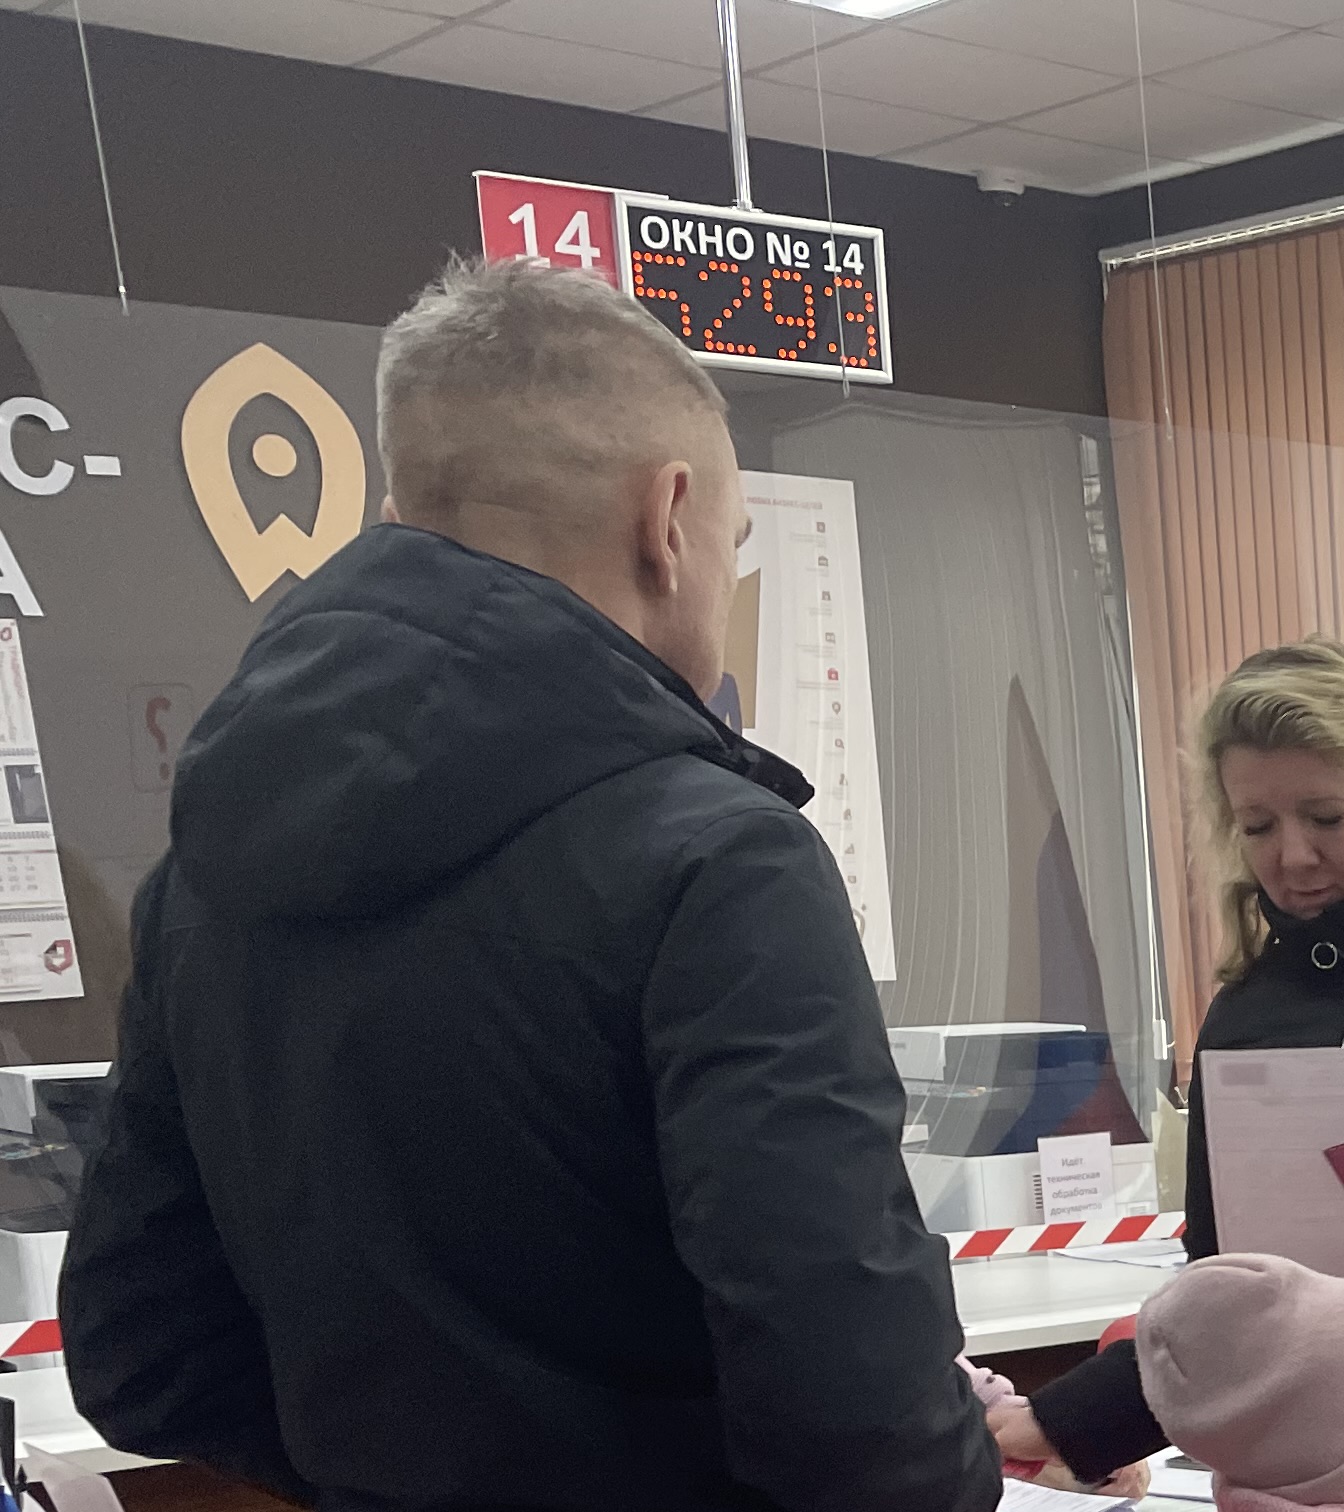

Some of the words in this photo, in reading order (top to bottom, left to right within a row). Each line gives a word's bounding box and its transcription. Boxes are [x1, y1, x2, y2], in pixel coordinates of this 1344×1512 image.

[507, 202, 601, 268] 14
[640, 214, 755, 262] ОКНО
[767, 231, 812, 269] №
[822, 239, 865, 276] 14
[632, 250, 878, 368] 5293
[1051, 1186, 1098, 1199] обработка
